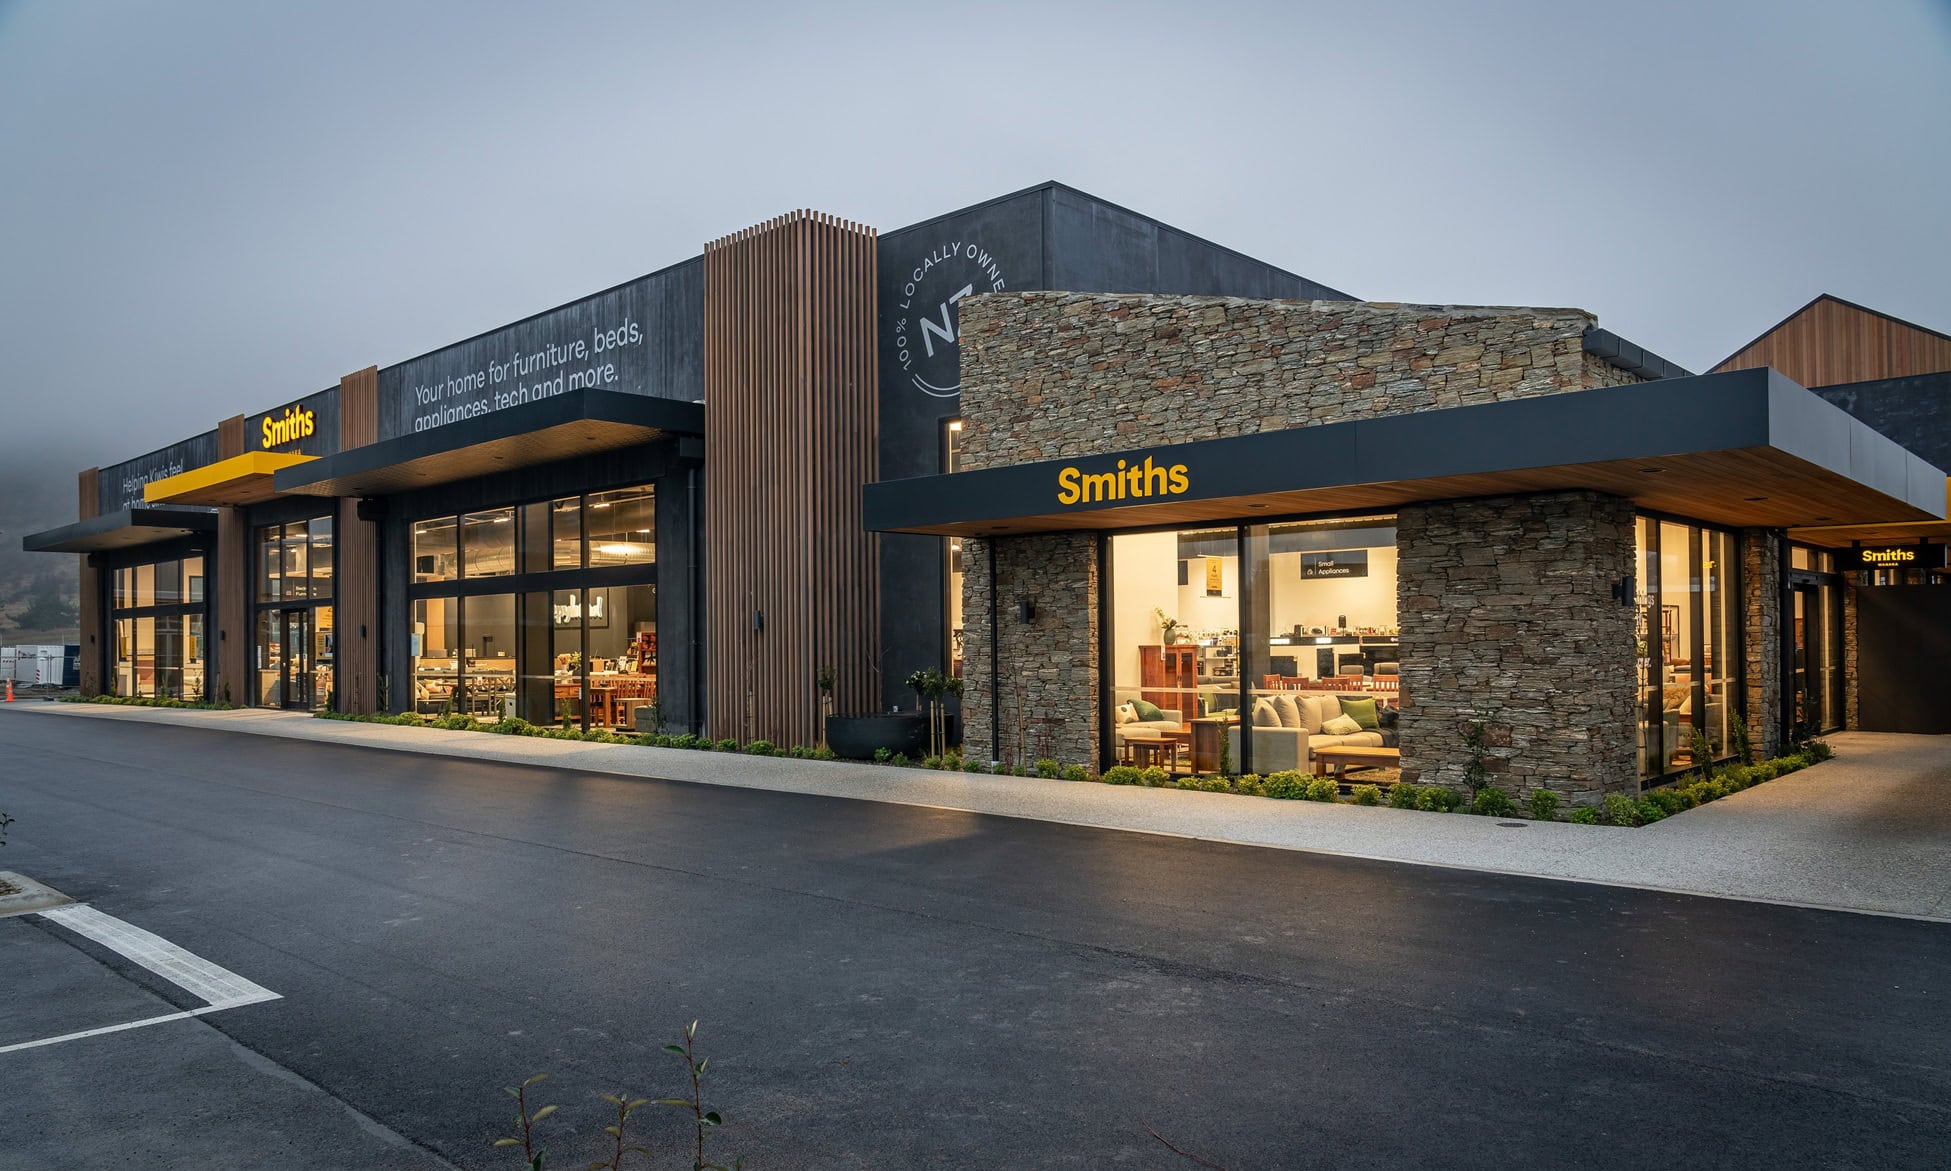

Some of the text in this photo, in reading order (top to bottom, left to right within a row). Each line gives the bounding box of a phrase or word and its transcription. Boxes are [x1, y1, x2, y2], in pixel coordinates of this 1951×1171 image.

[900, 241, 961, 310] LOCALLY
[415, 317, 644, 406] Your home for furniture, beds,
[896, 317, 912, 371] 100%
[494, 382, 528, 410] tech
[532, 370, 563, 401] and
[569, 363, 618, 391] more.
[262, 404, 314, 449] Smiths
[1057, 455, 1190, 505] Smiths
[1862, 548, 1915, 562] Smiths
